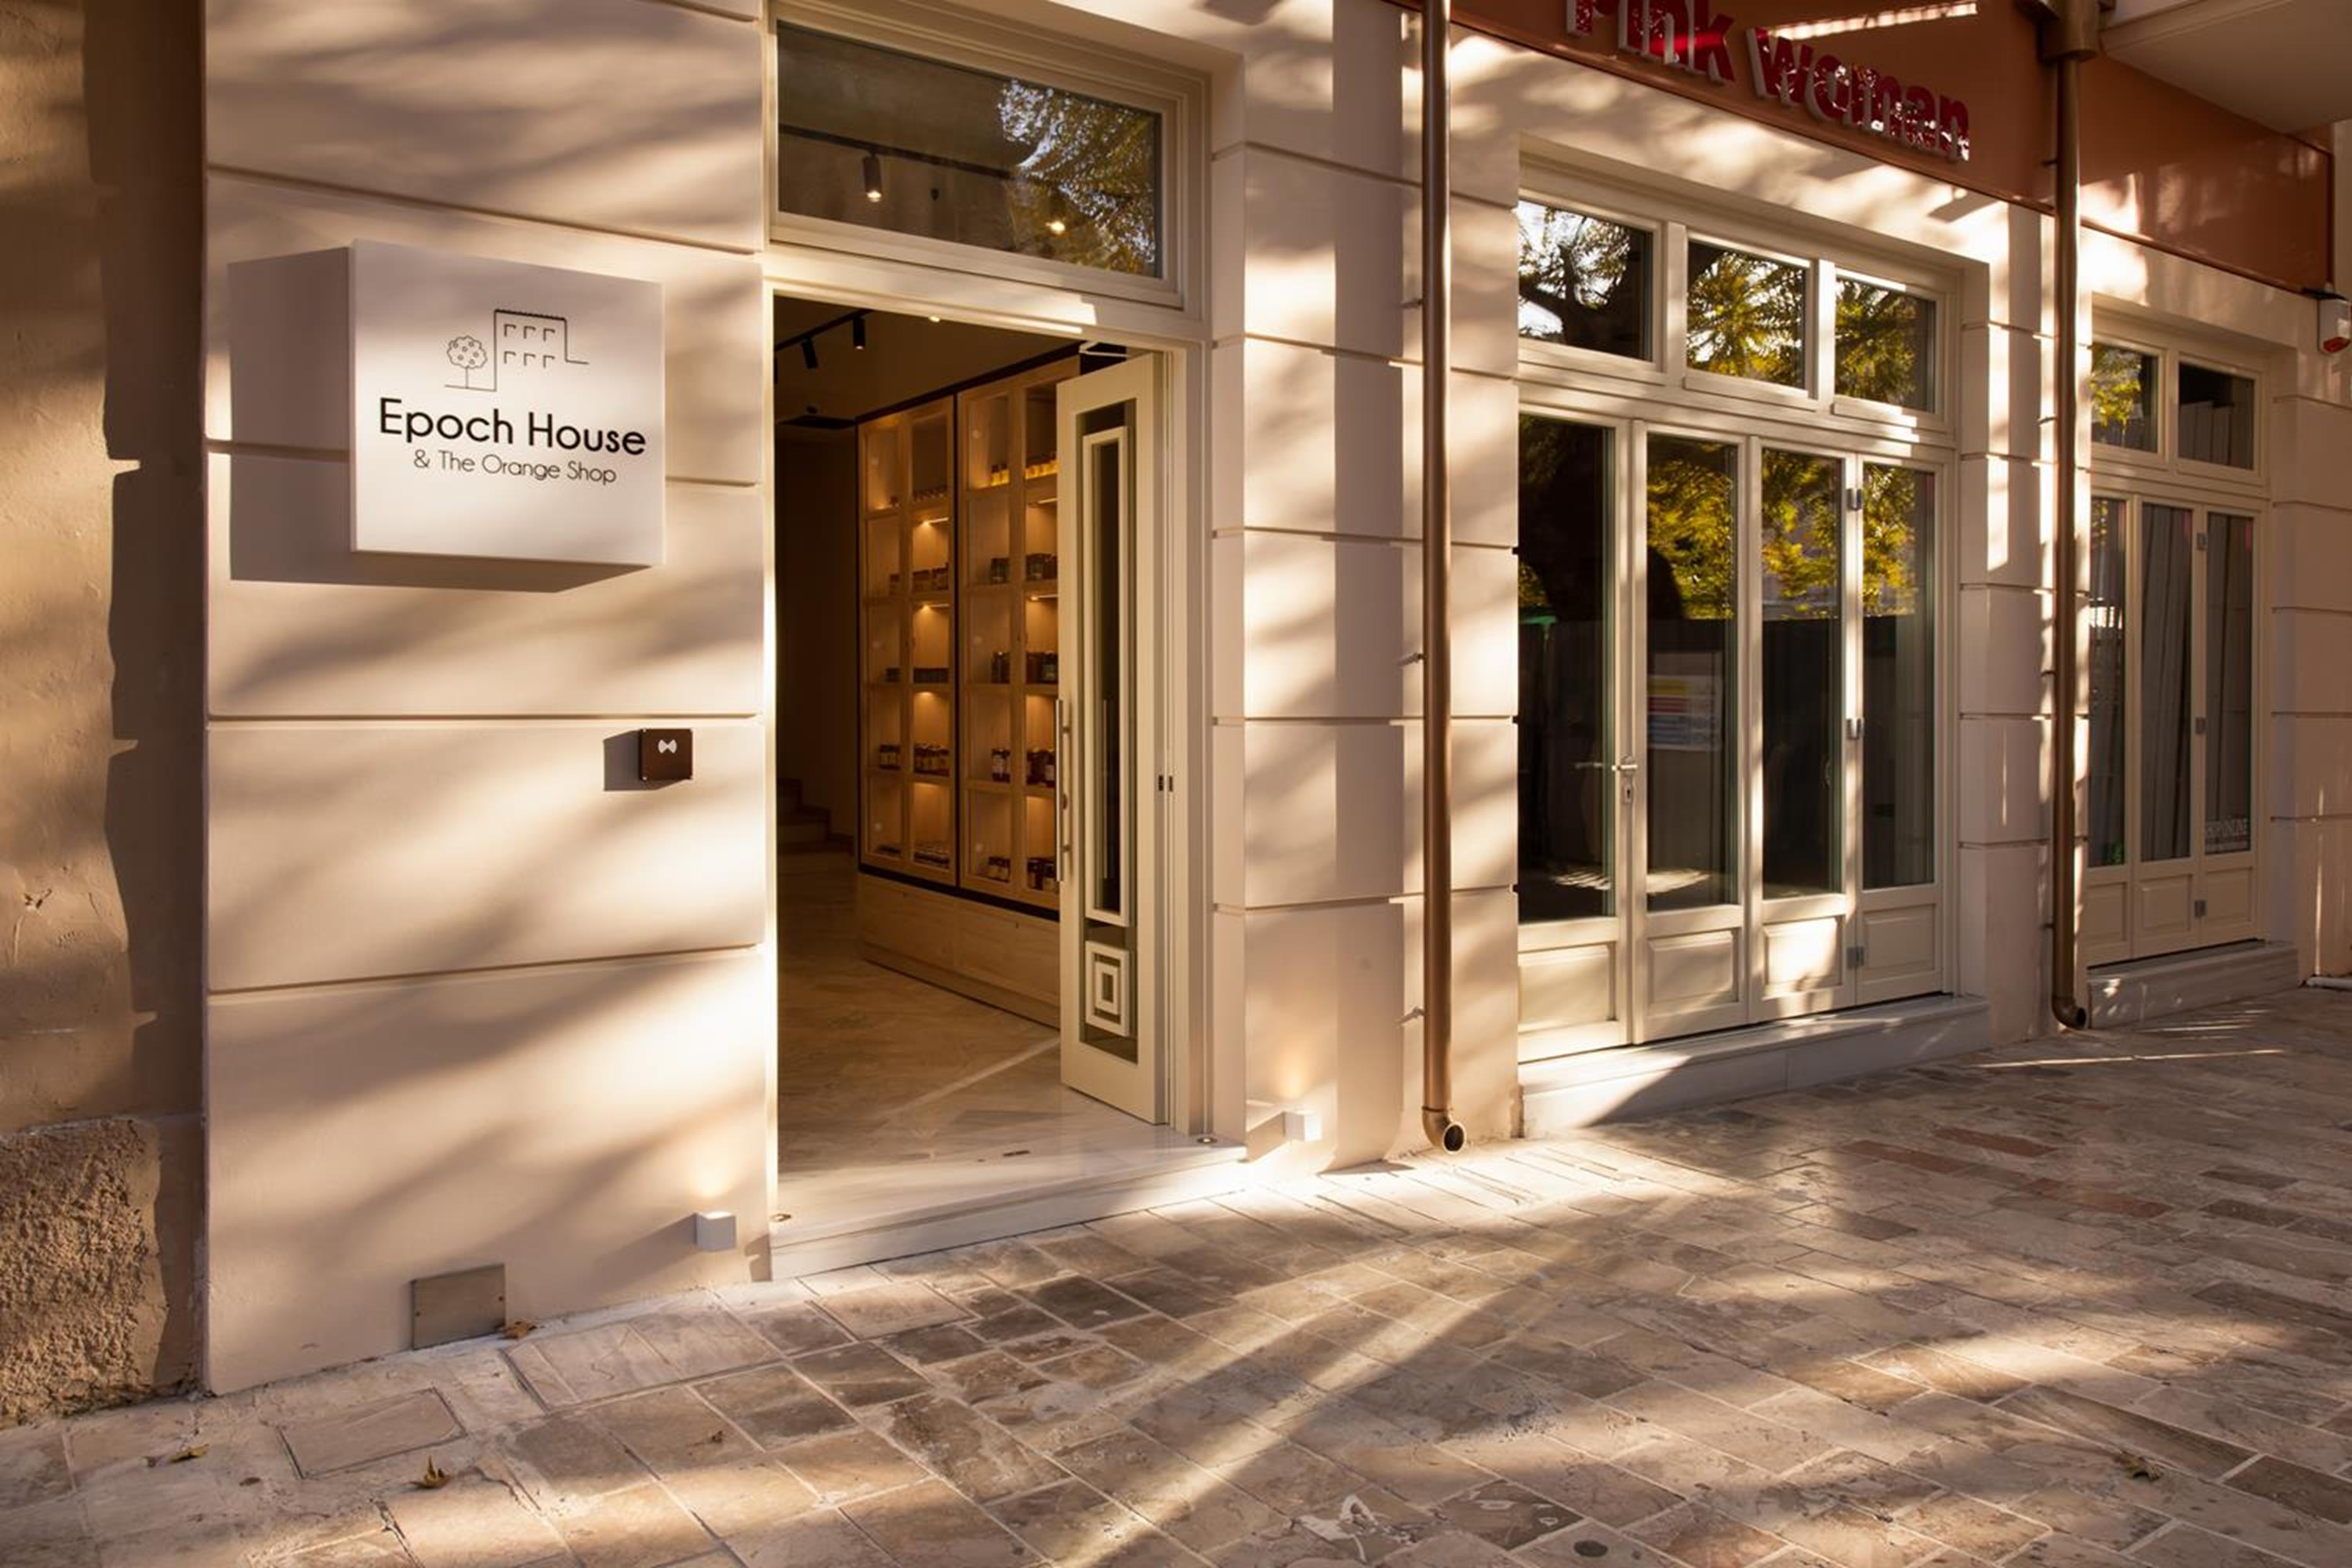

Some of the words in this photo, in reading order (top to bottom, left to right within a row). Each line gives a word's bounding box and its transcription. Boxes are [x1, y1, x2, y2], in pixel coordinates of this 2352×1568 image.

[1746, 27, 1969, 161] Woman
[380, 397, 513, 444] Epoch
[528, 412, 646, 455] House
[413, 449, 430, 468] &
[438, 450, 475, 472] The
[481, 454, 561, 481] Orange
[567, 460, 617, 485] Shop
